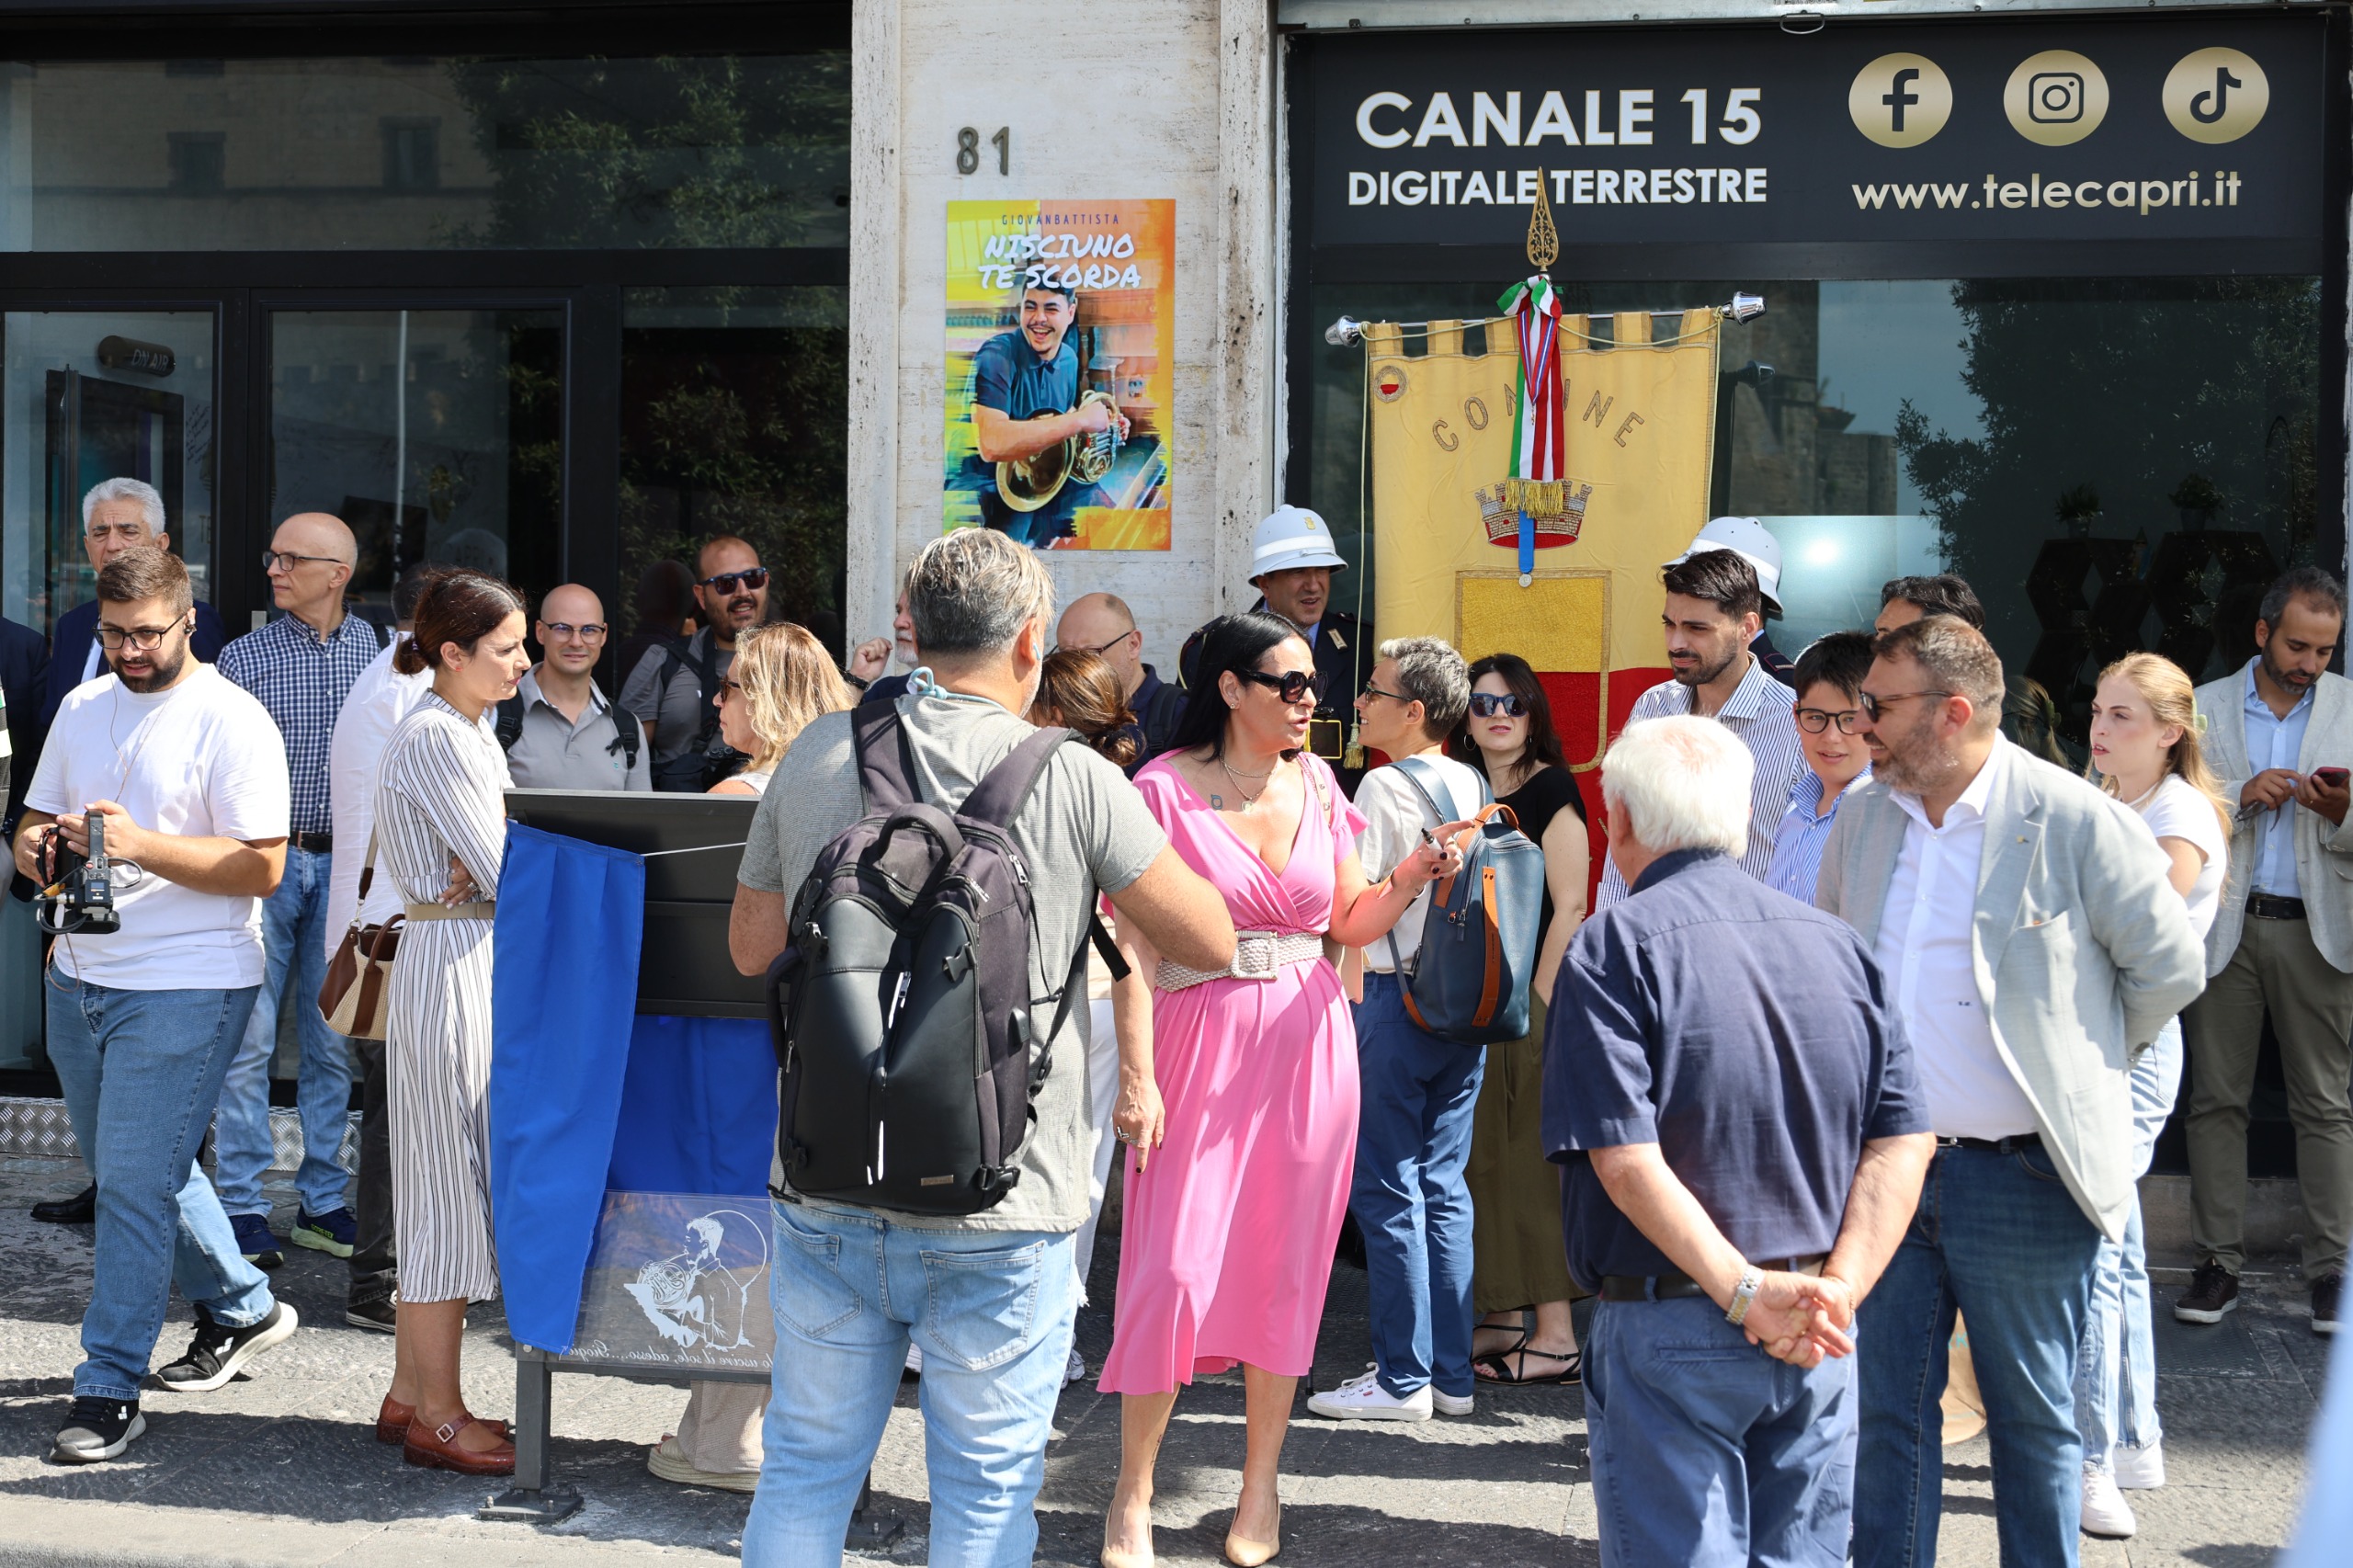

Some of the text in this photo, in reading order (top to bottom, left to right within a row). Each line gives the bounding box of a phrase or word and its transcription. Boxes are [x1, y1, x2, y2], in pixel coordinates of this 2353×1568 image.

[1356, 87, 1761, 149] CANALE 15
[957, 126, 1009, 176] 81
[1348, 167, 1768, 206] DIGITALE TERRESTRE
[1851, 170, 2242, 216] www.telecapri.it
[1002, 213, 1119, 225] GIOVANBATTISTA
[983, 233, 1135, 260] NISCIUNO
[978, 263, 1142, 290] TE SCORDA
[131, 348, 169, 372] ON AIR
